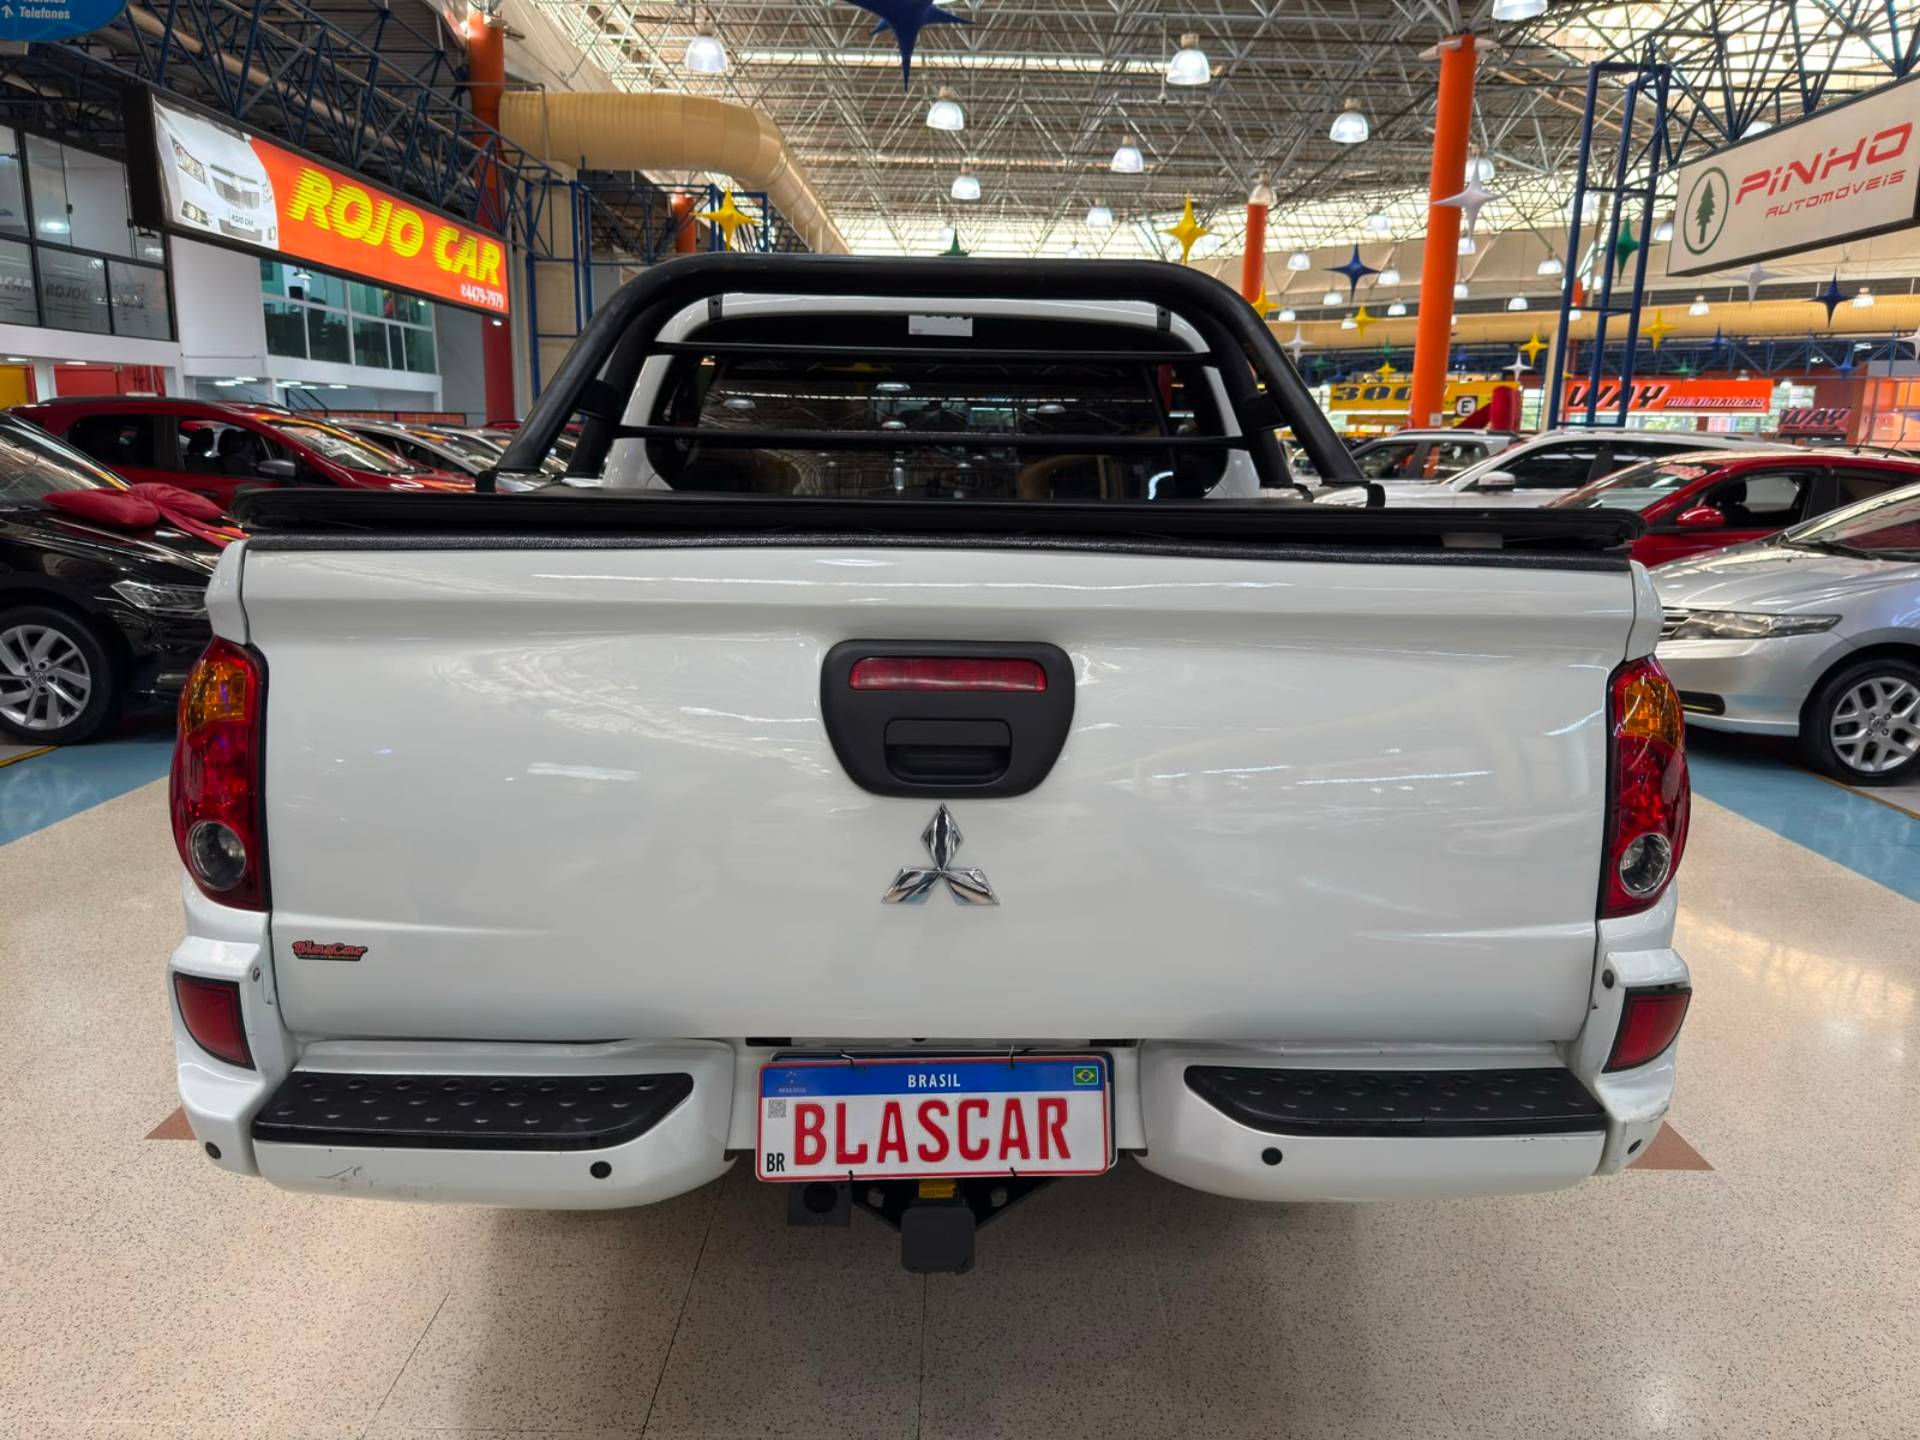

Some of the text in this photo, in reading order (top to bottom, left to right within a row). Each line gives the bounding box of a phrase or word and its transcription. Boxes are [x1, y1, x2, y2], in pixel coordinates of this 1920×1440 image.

[19, 6, 71, 20] Telefones
[287, 166, 501, 286] ROJO CAR
[1779, 408, 1850, 427] WAY
[907, 1073, 962, 1089] BRASIL
[794, 1097, 1071, 1166] BLASCAR
[766, 1152, 786, 1172] BR
